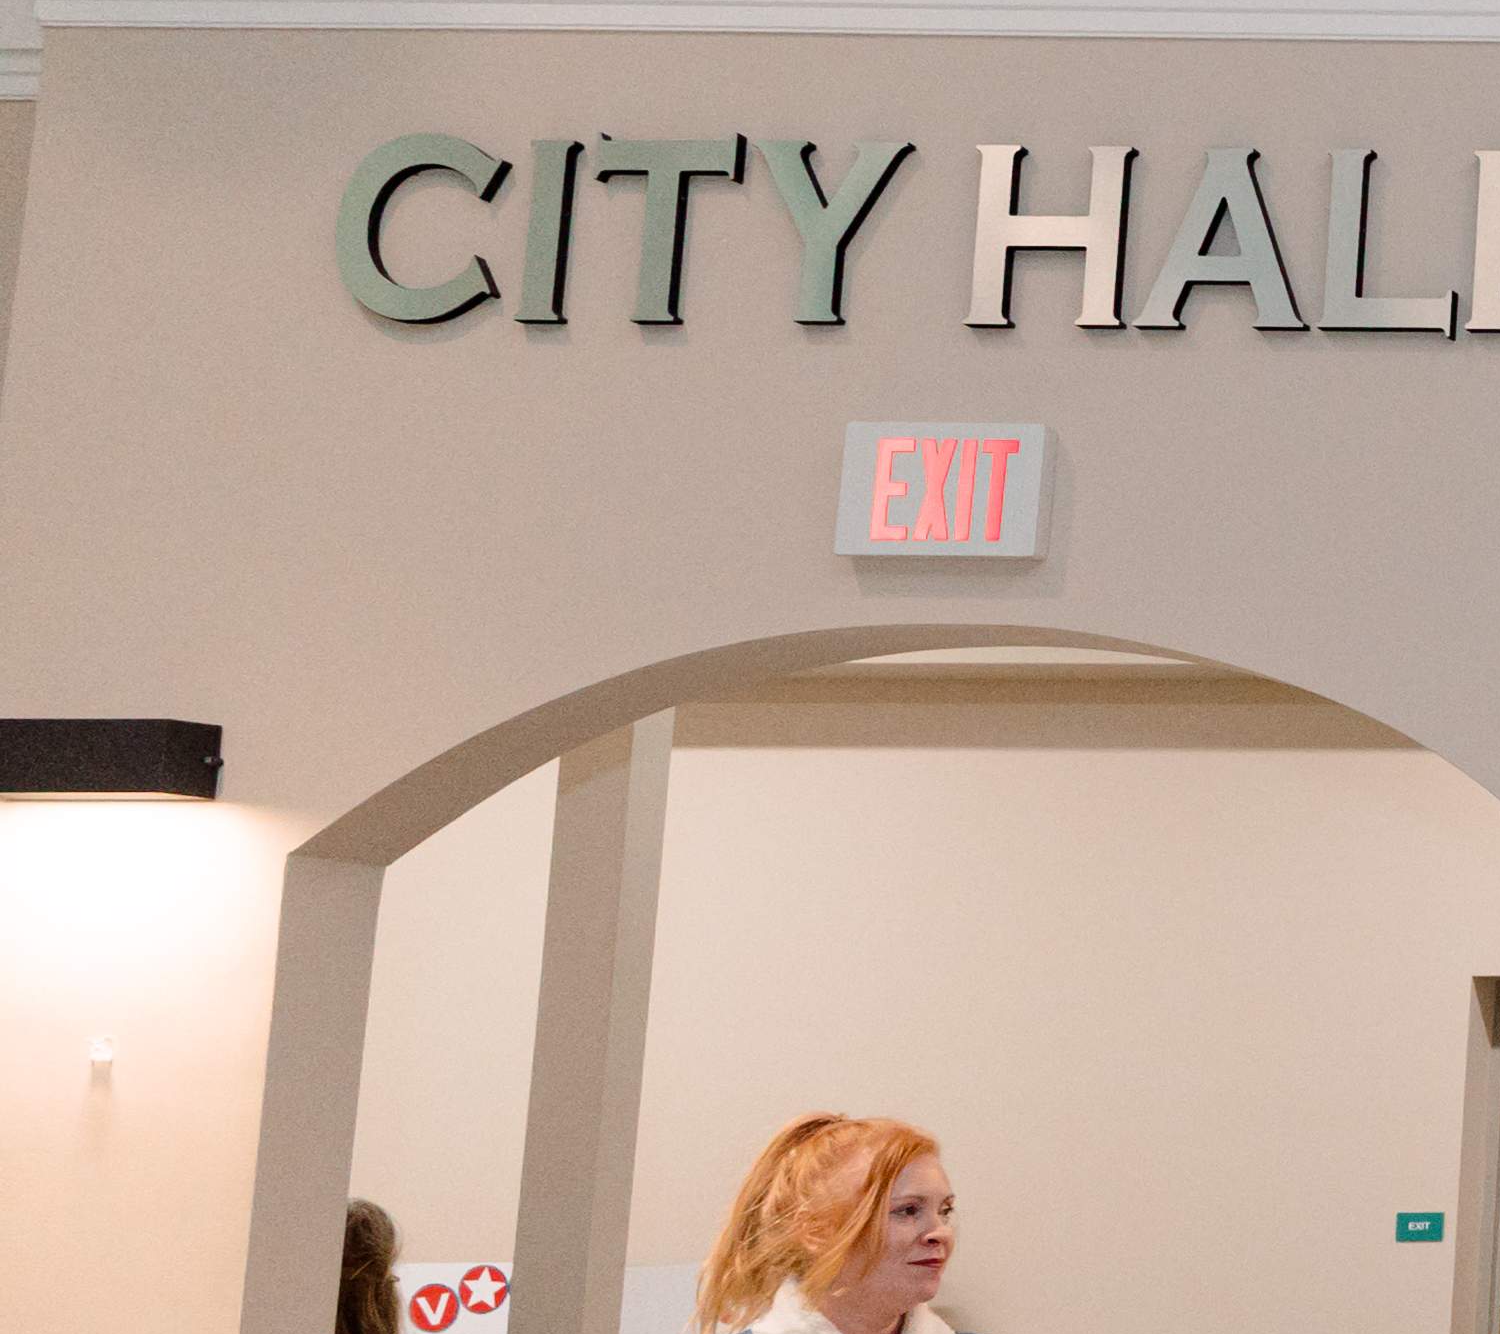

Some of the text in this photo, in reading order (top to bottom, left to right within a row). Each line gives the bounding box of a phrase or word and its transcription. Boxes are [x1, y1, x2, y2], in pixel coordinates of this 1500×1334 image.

[336, 132, 917, 325] CITY
[869, 437, 1021, 543] EXIT
[1408, 1222, 1430, 1230] EXIT
